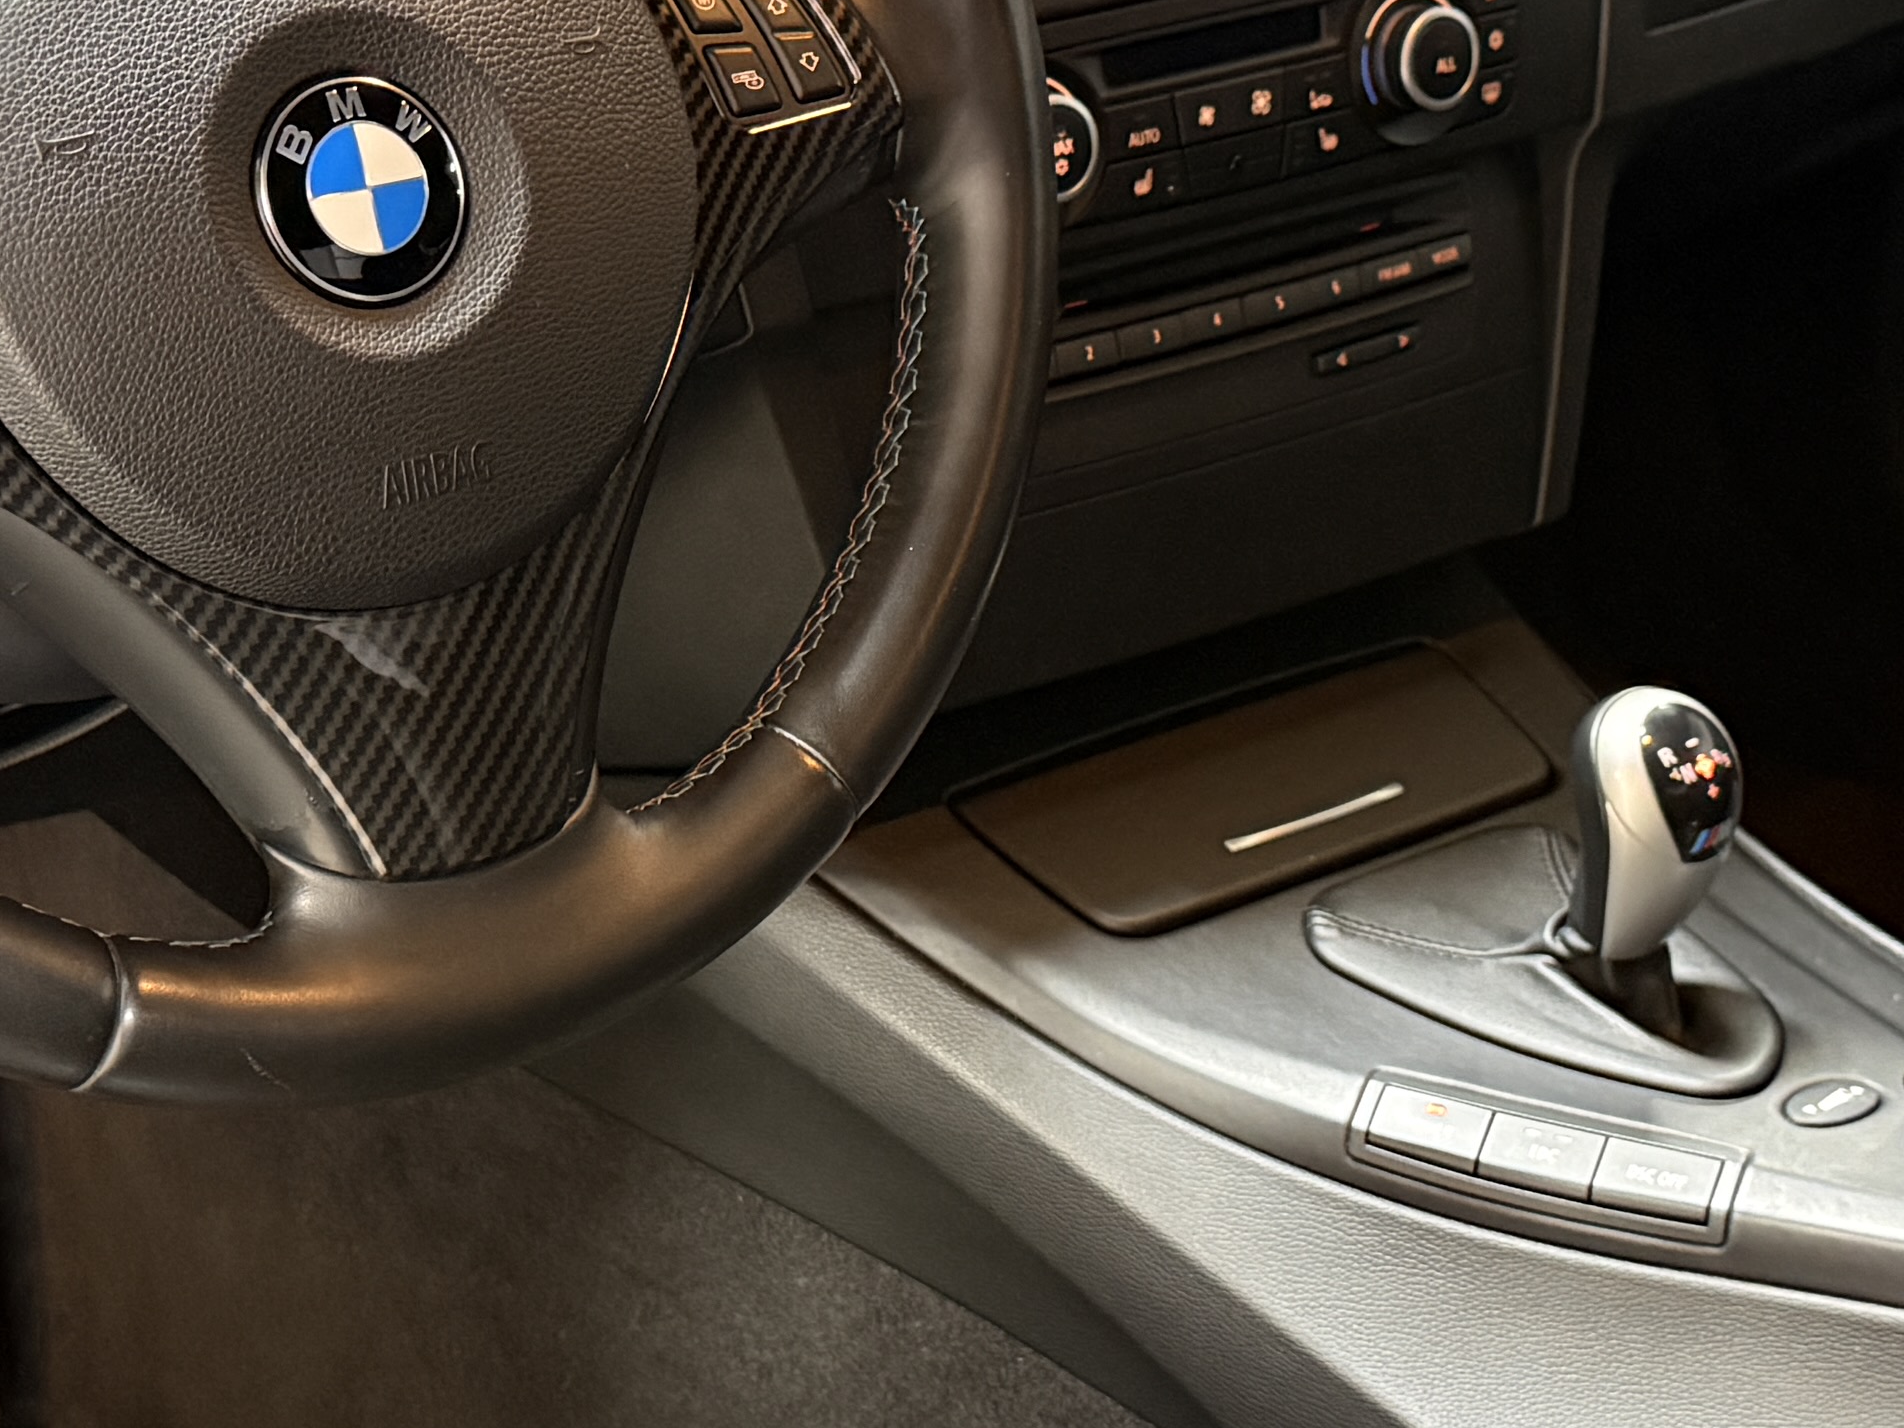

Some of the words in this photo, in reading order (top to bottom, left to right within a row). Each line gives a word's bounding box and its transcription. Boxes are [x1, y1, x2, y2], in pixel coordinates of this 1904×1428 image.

[275, 85, 432, 165] BMW
[1127, 126, 1162, 149] AUTO
[383, 440, 494, 510] AIRBAG
